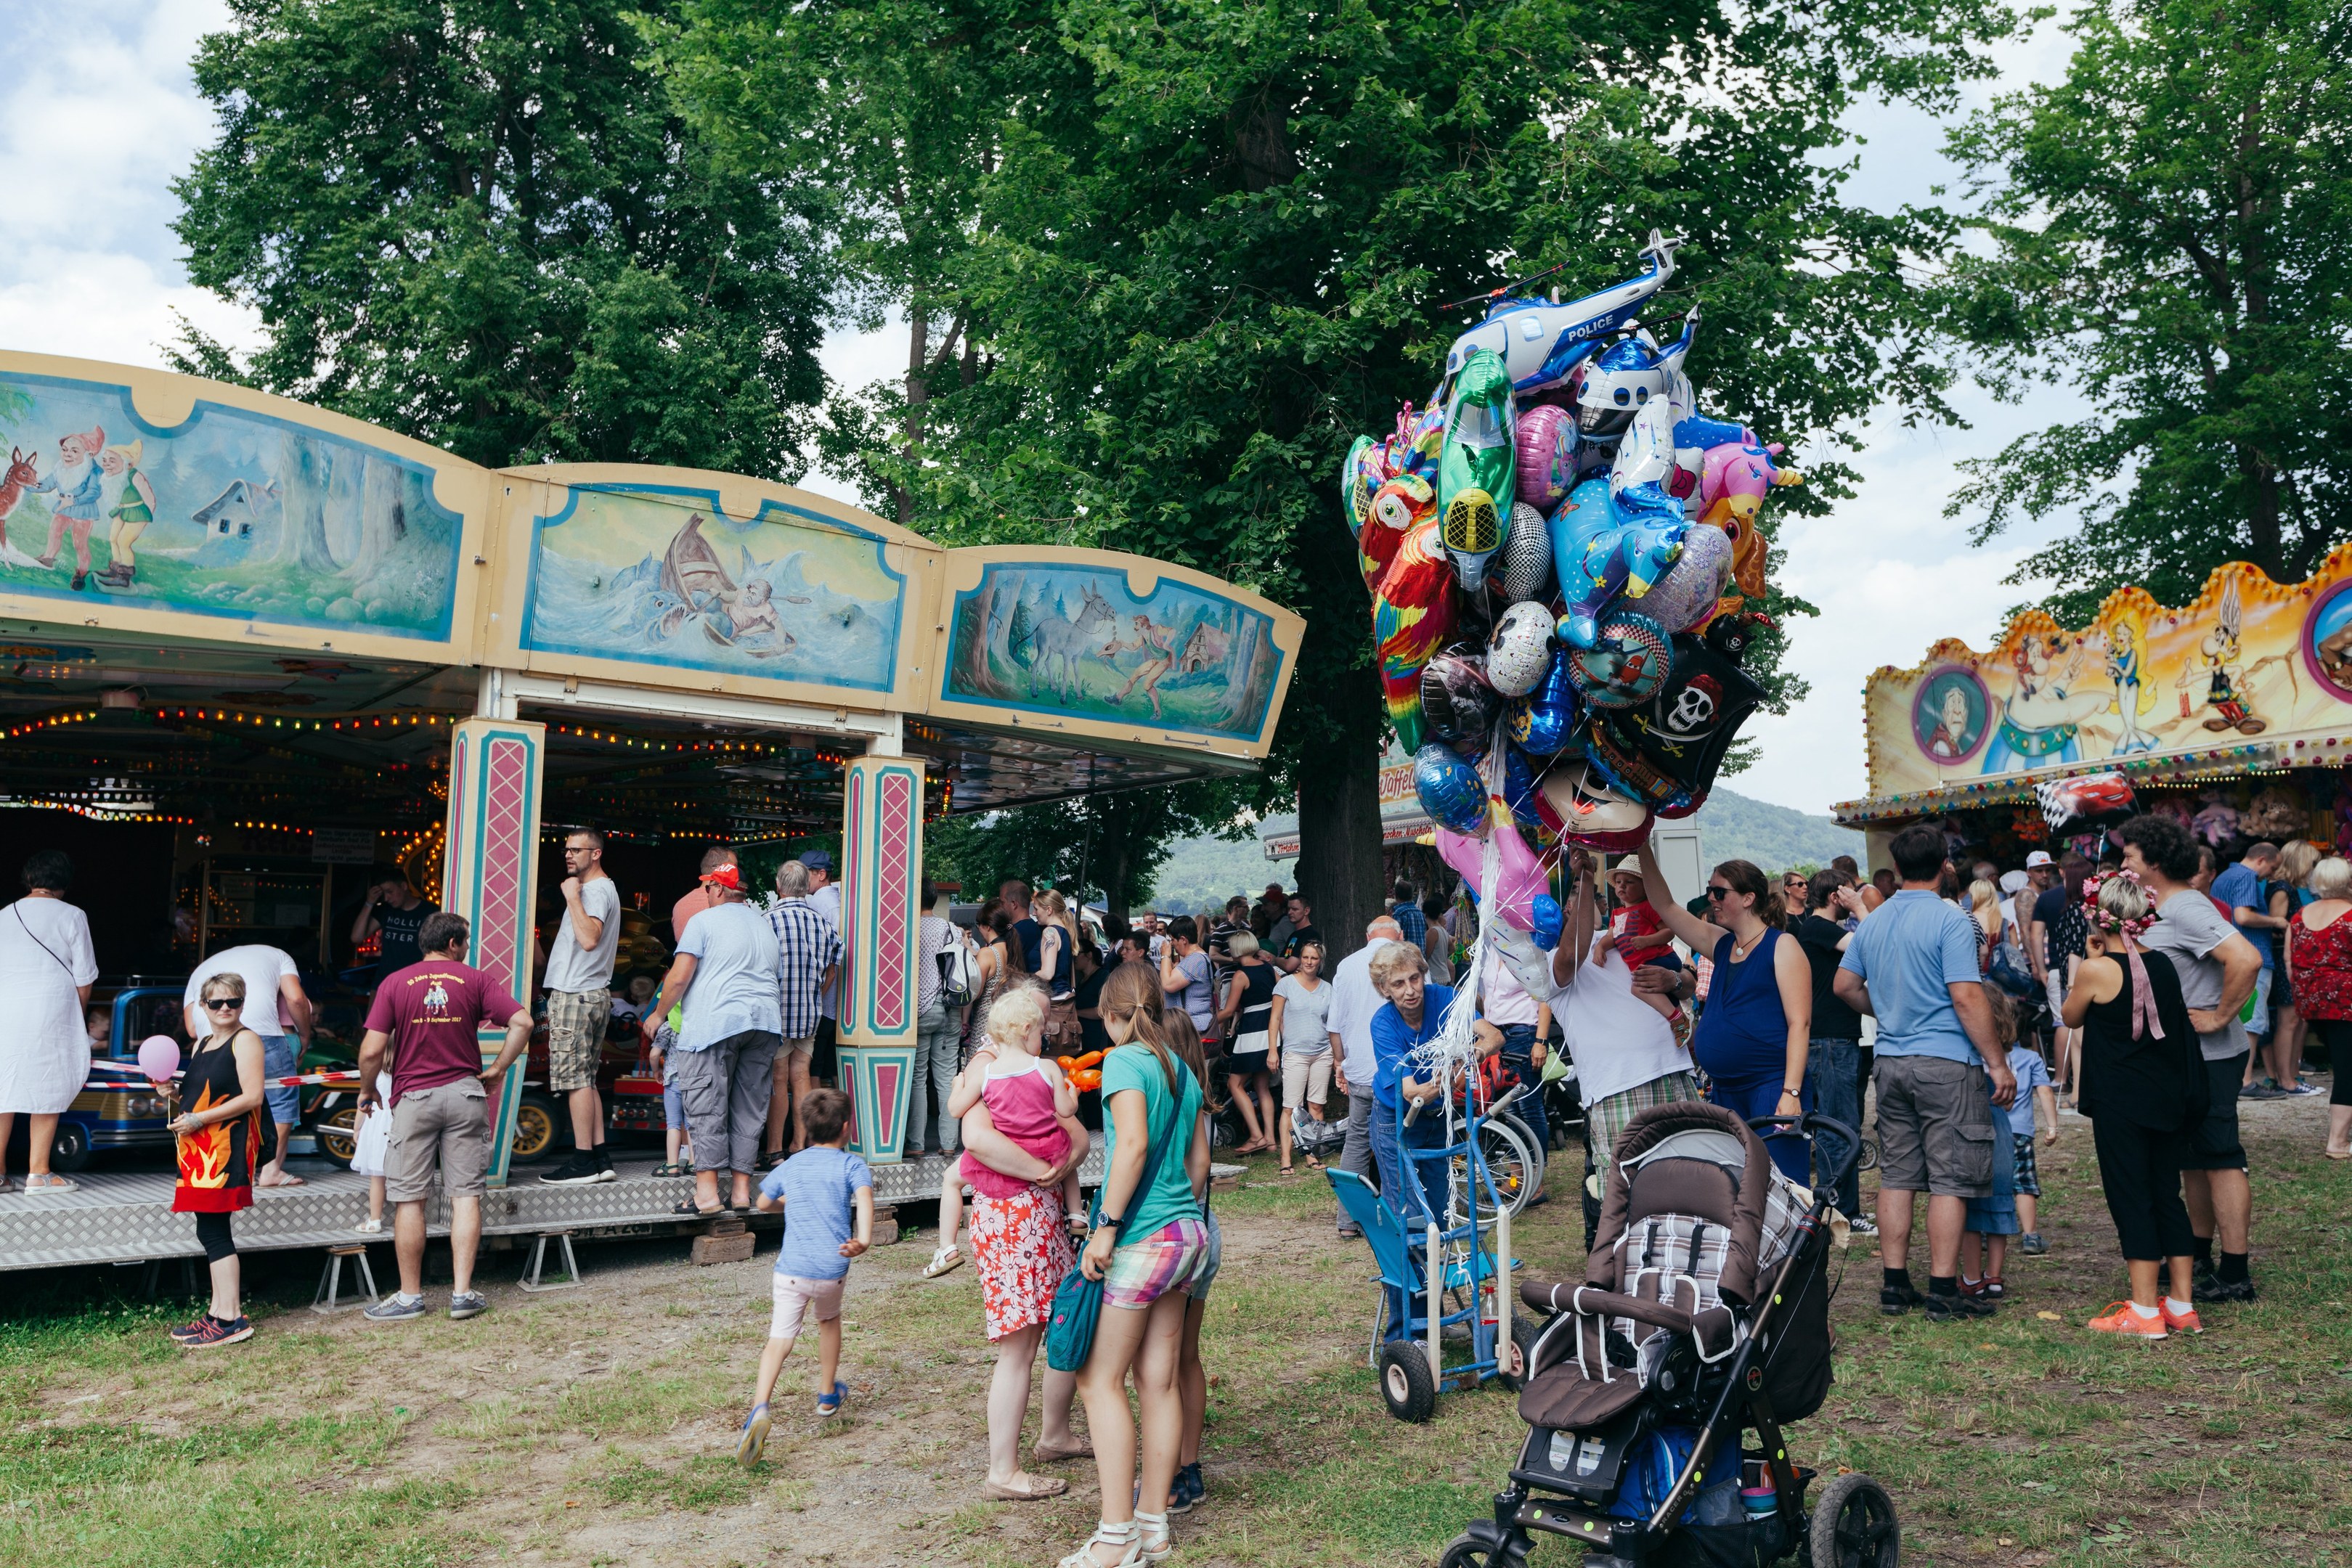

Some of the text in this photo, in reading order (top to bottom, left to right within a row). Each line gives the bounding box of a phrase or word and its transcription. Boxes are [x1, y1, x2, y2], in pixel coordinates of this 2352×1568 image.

[1568, 314, 1614, 342] POLICE
[386, 915, 421, 927] HOLLI
[385, 931, 414, 942] STER
[1661, 1495, 1682, 1524] RACER
